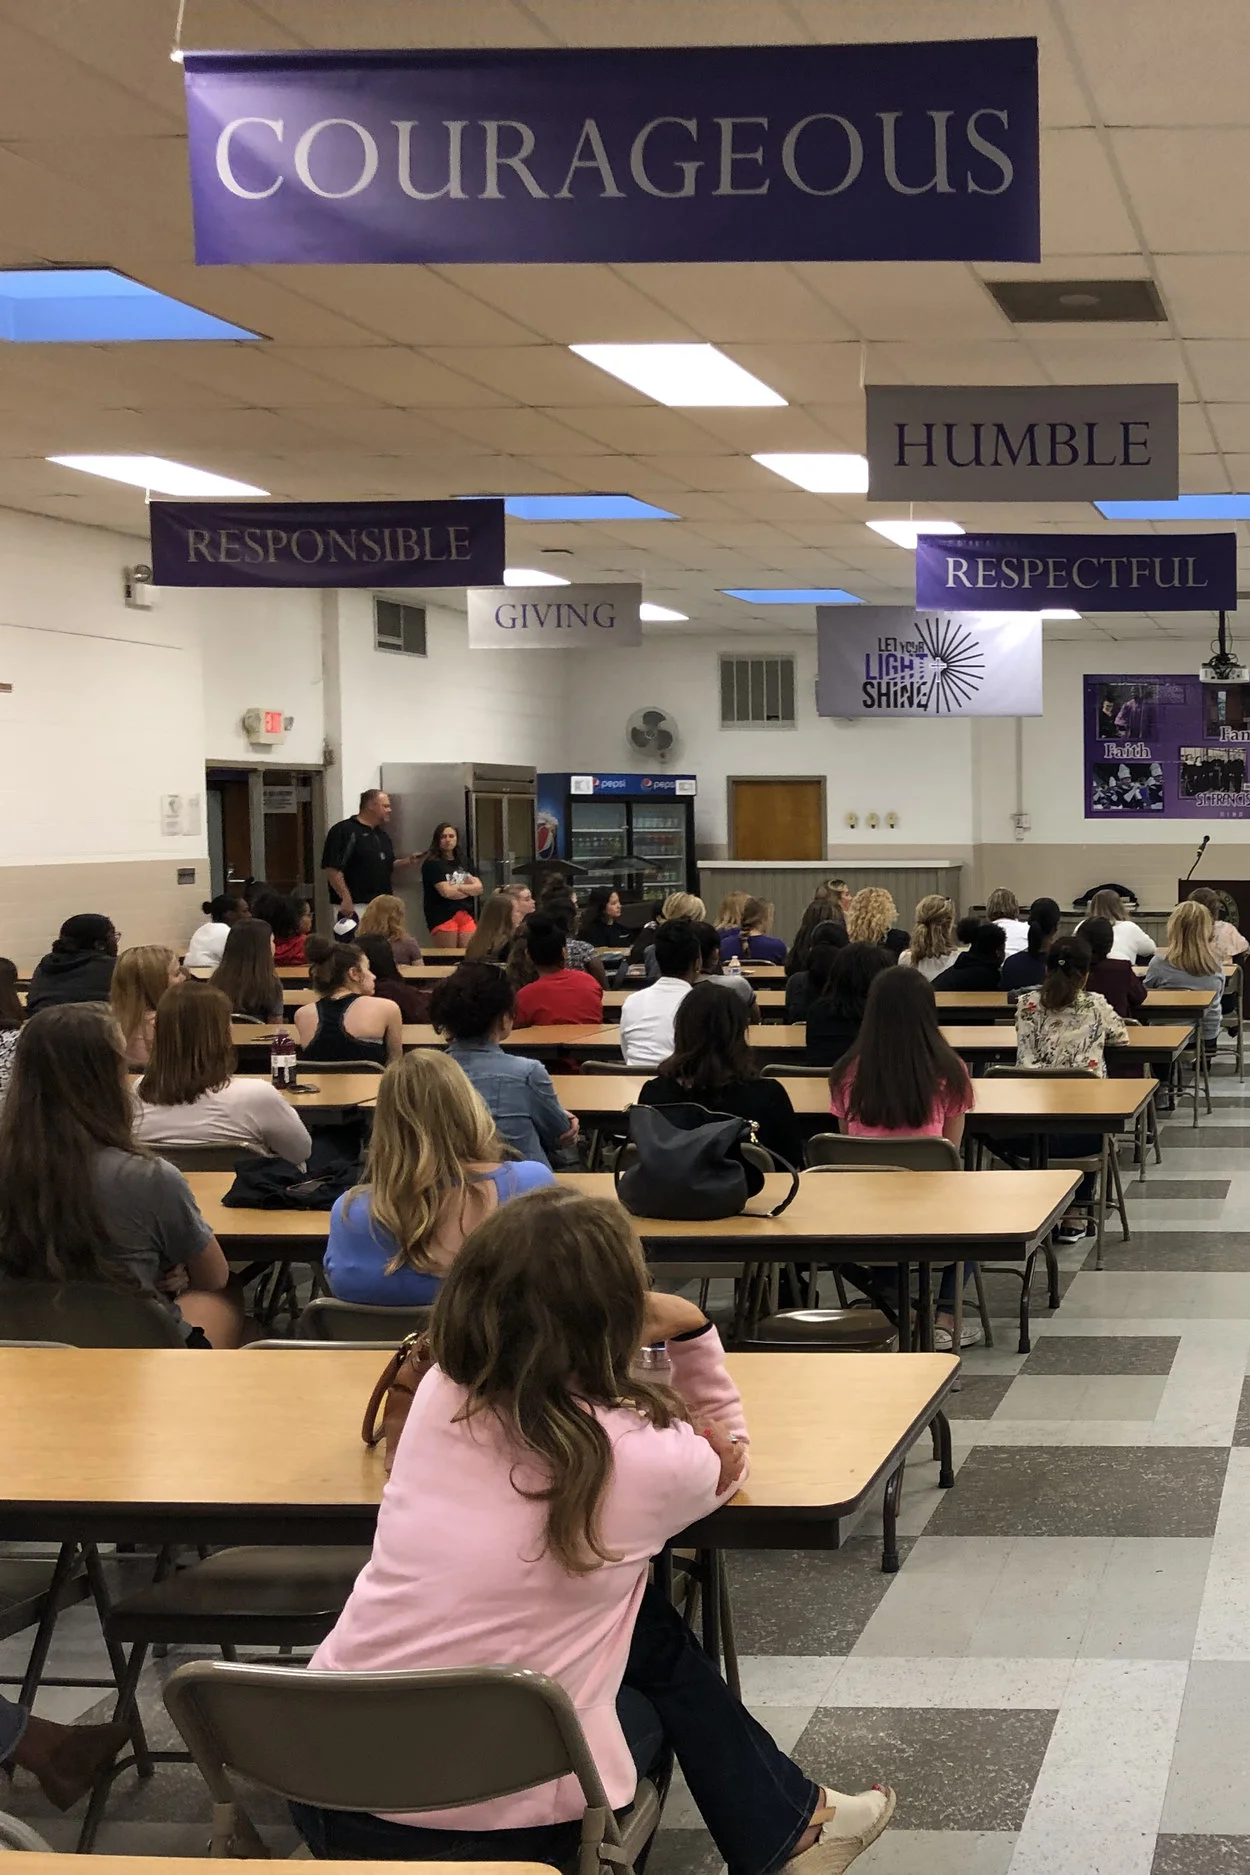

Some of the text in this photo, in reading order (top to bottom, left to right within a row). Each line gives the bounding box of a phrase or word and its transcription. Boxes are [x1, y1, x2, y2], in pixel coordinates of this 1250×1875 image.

[214, 108, 1015, 201] COURAGEOUS
[894, 421, 1152, 468] HUMBLE
[187, 526, 473, 564] RESPONSIBLE
[945, 557, 1209, 589] RESPECTFUL
[494, 602, 616, 630] GIVING
[878, 637, 925, 654] LET YOUR
[865, 653, 928, 681] LIGHT
[862, 680, 928, 709] SHINE
[1104, 742, 1151, 759] Faith
[601, 779, 626, 789] pepsi
[653, 781, 676, 790] peps
